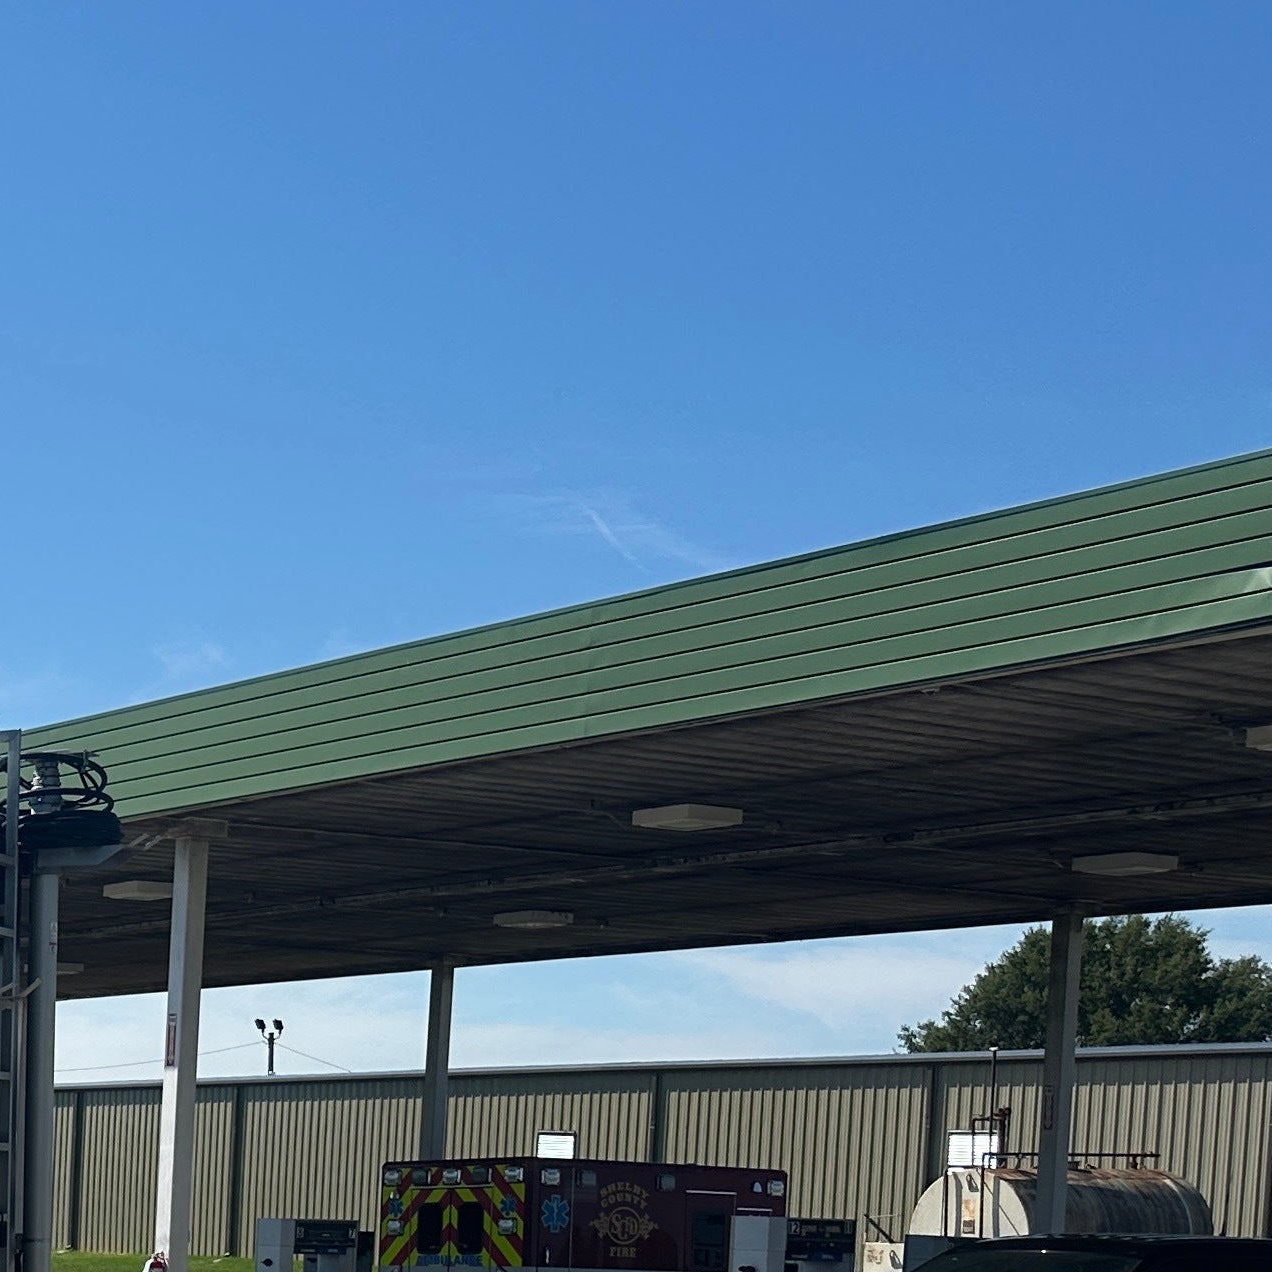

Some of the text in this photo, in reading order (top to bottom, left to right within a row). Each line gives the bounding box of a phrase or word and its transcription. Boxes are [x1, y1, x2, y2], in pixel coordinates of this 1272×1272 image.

[599, 1182, 649, 1199] SHELBY
[601, 1194, 648, 1209] COUNTY
[789, 1222, 799, 1234] 12
[609, 1247, 637, 1258] FIRE
[416, 1255, 483, 1267] AMBULANCE
